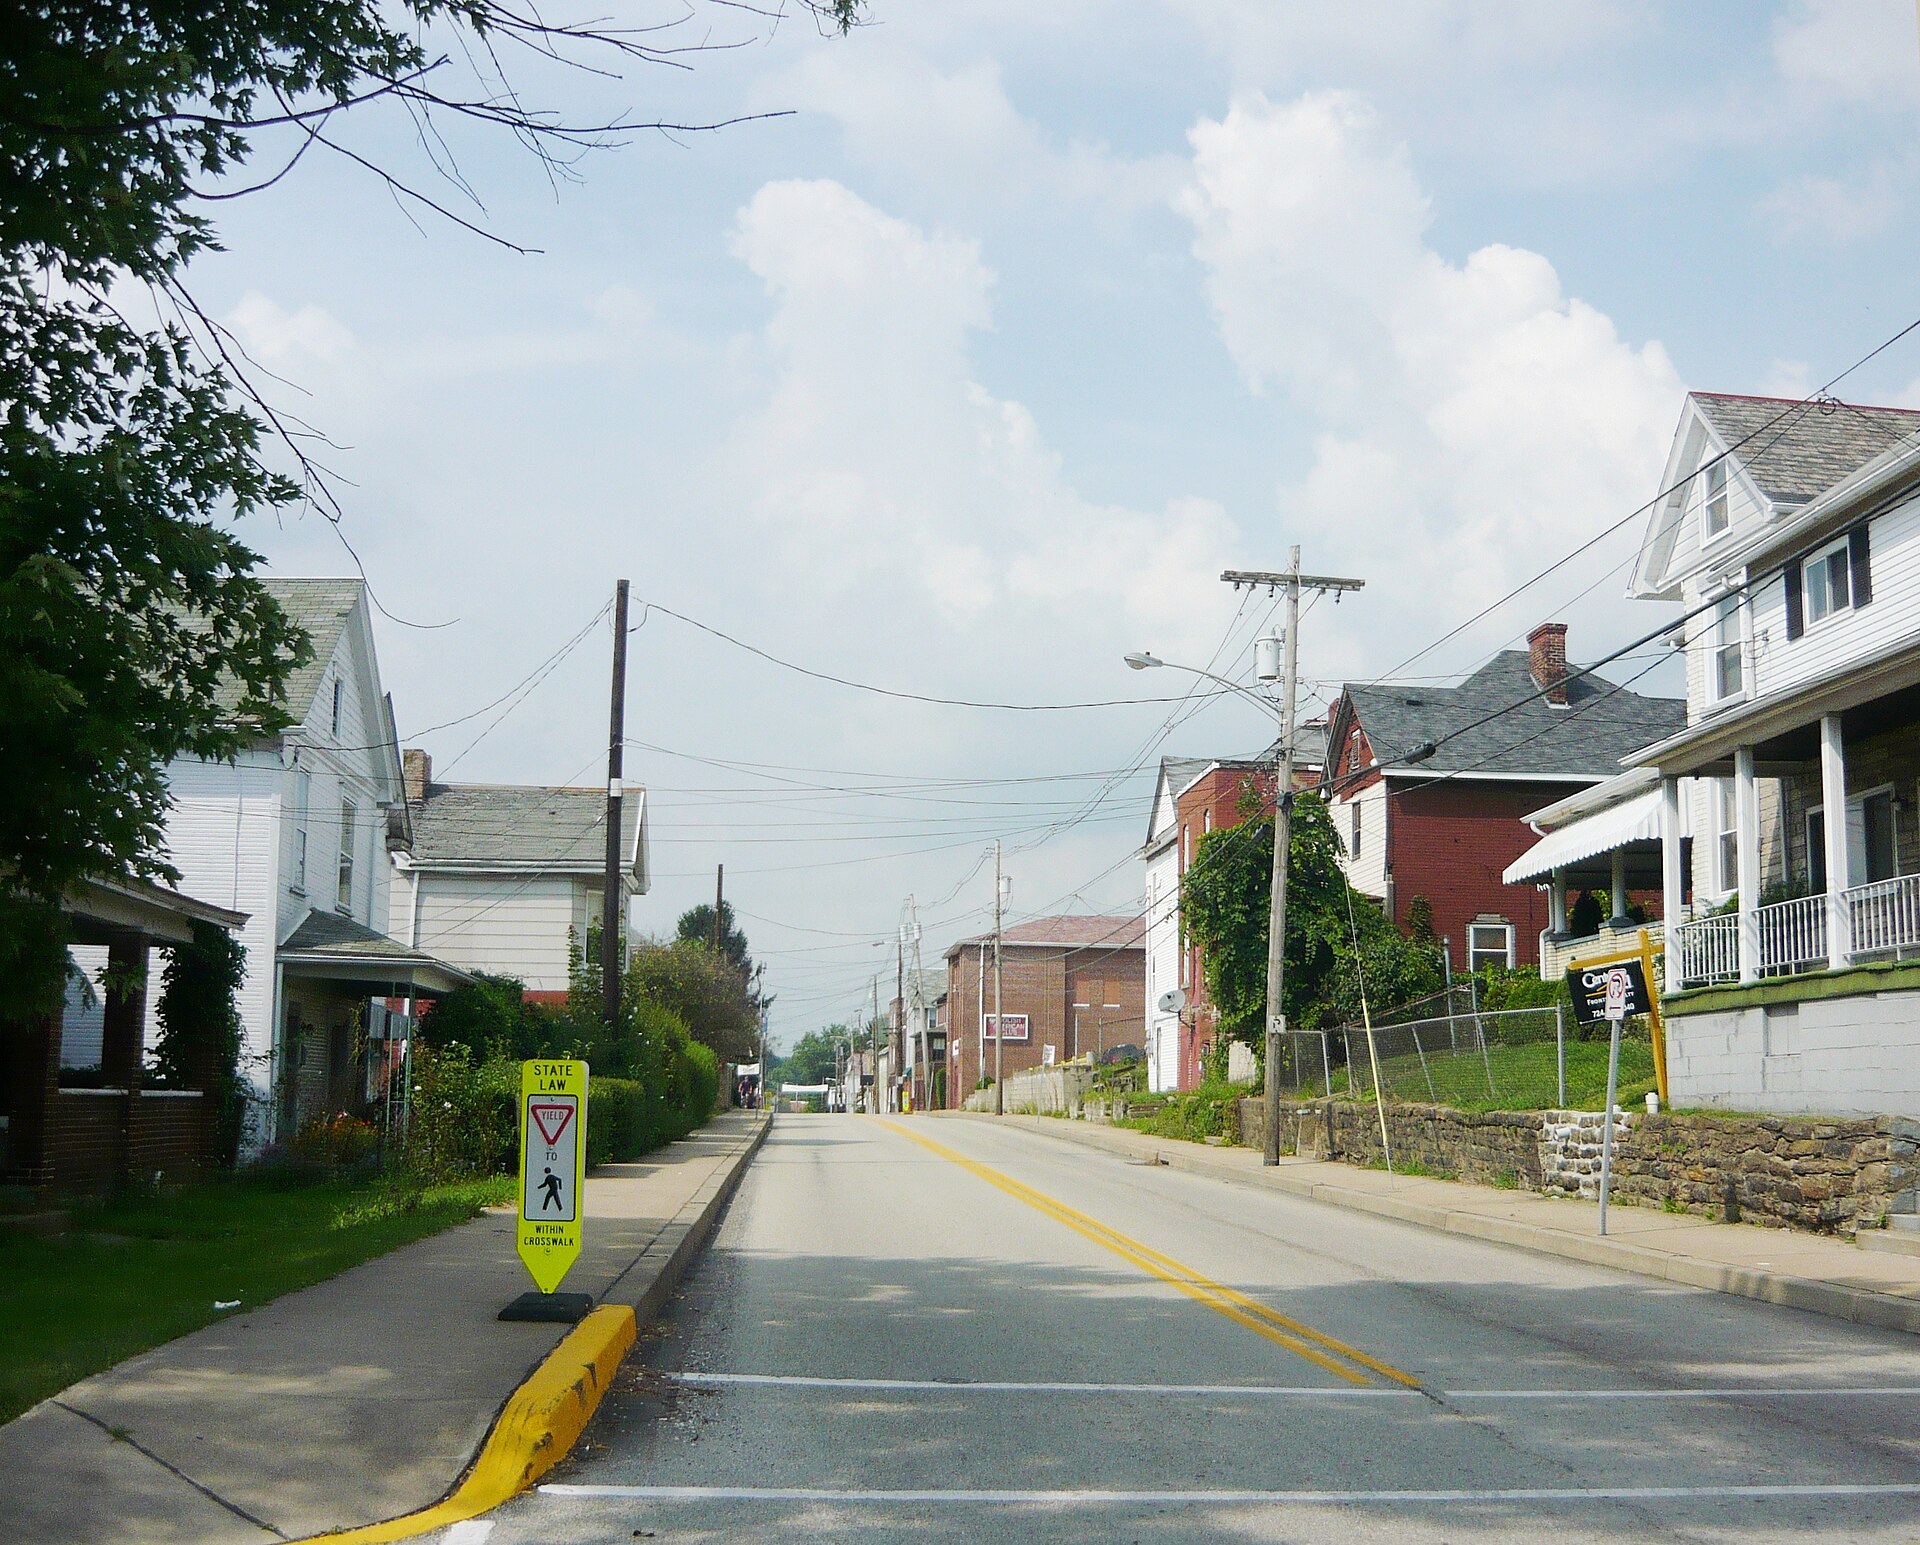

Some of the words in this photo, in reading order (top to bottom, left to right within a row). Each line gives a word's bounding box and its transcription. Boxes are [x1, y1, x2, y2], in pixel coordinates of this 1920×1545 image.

[534, 1064, 573, 1076] STATE
[540, 1079, 566, 1091] LAW
[541, 1111, 564, 1121] YIELD
[545, 1151, 558, 1162] TO
[535, 1224, 564, 1234] WITHIN
[523, 1236, 574, 1247] CROSSWALK
